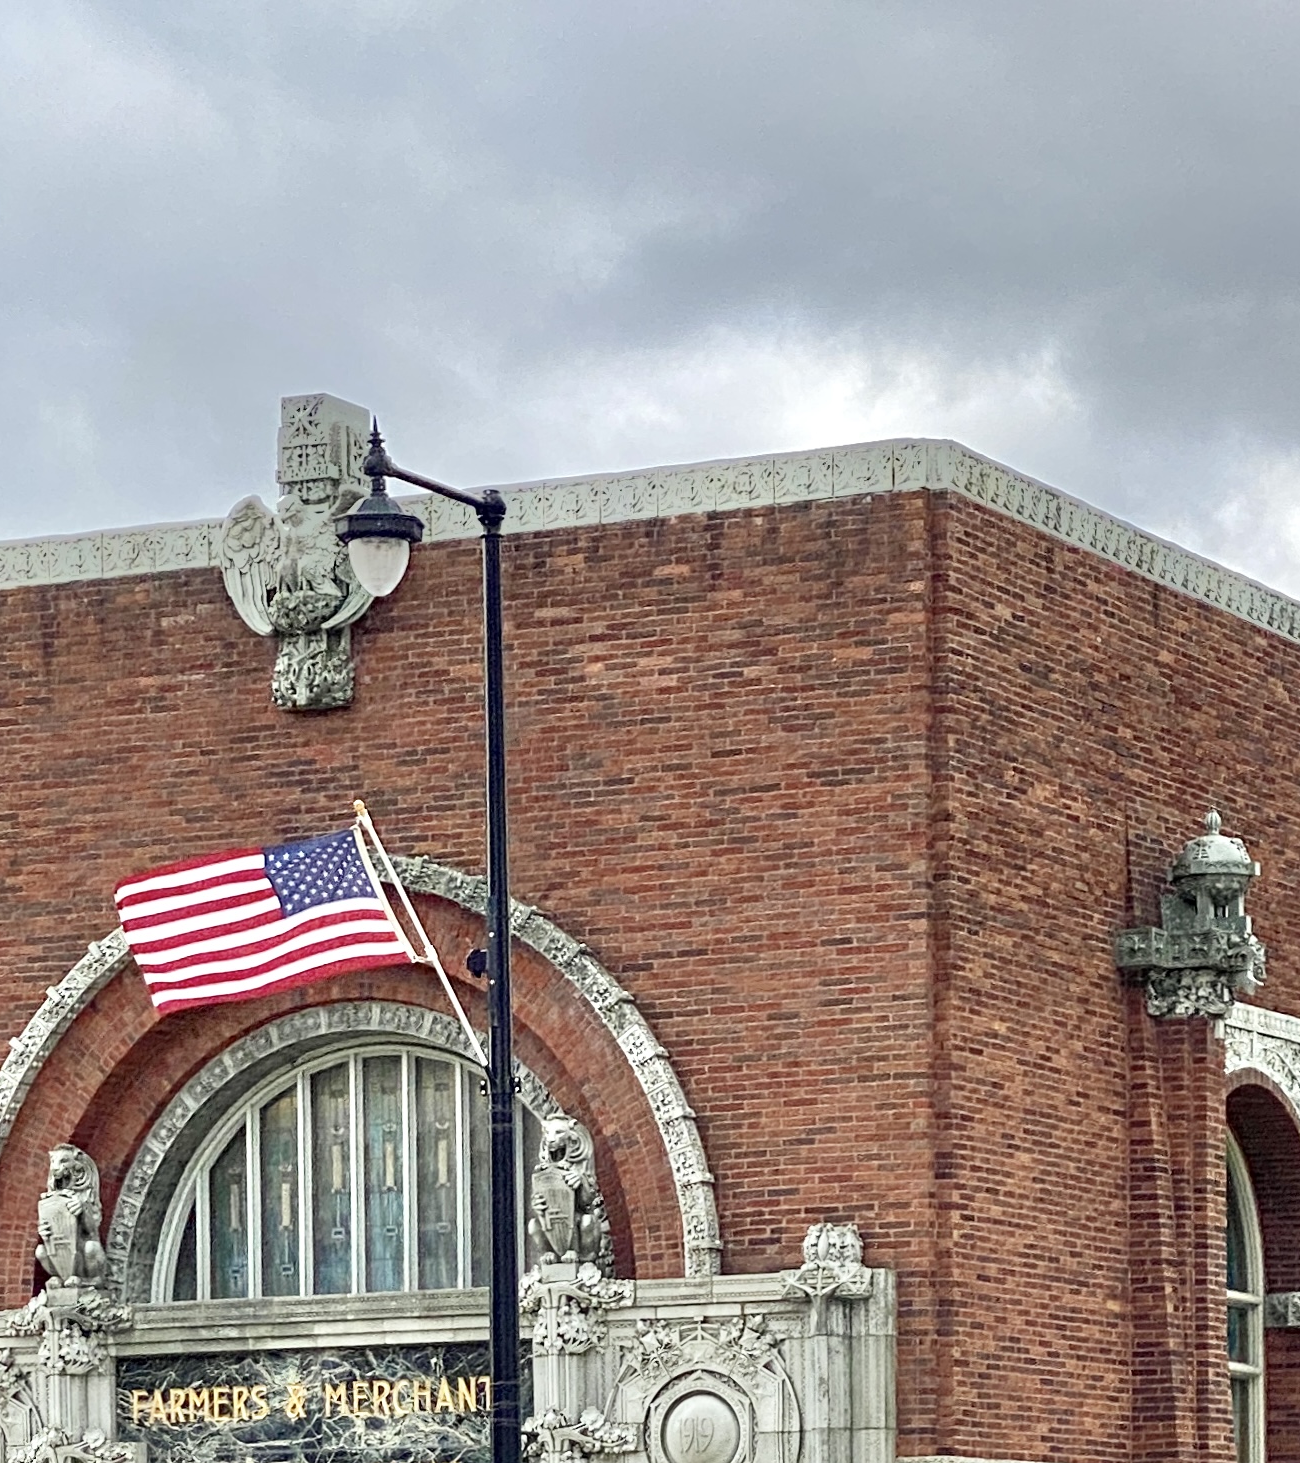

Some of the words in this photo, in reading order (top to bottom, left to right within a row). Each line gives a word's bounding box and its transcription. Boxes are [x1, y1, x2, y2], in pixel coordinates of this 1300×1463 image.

[132, 1385, 271, 1425] FARMERS
[286, 1383, 307, 1421] &
[325, 1375, 491, 1418] MERCHANT
[680, 1416, 715, 1454] 1919
